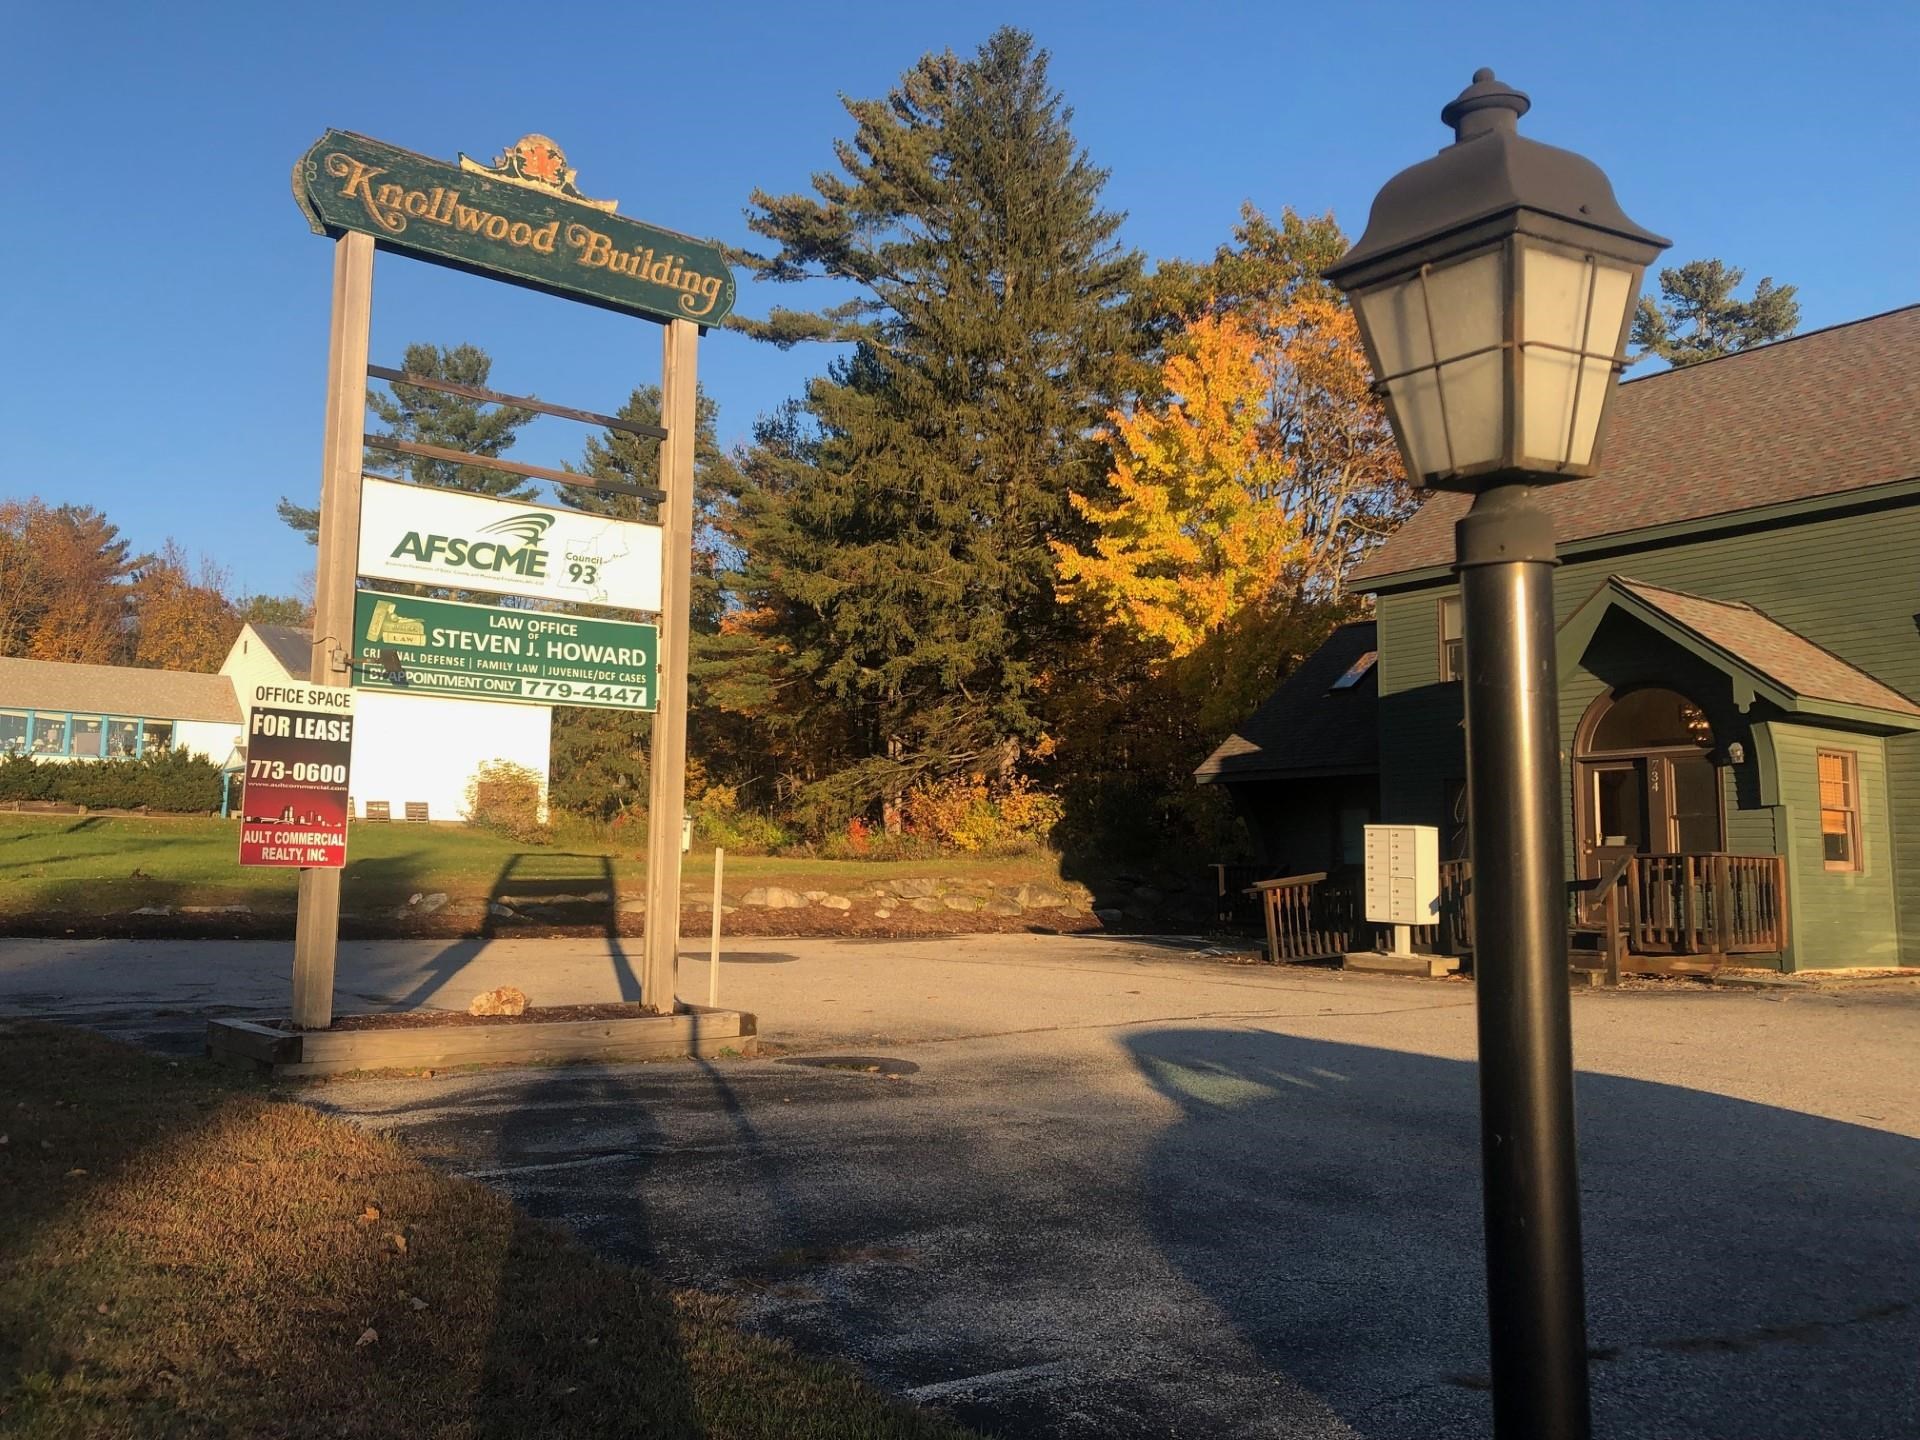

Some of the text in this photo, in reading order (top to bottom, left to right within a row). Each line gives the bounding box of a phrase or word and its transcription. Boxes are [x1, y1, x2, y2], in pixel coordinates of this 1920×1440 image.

[324, 152, 724, 316] Knollwood Building
[390, 531, 549, 578] AFSCME
[565, 551, 603, 565] Council
[568, 563, 597, 585] 93
[489, 615, 578, 637] LAW OFFICE
[527, 632, 540, 641] OF
[431, 628, 647, 668] STEVEN J. HOWARD
[362, 647, 647, 684] CRINAL DEFENSE FAMILY LAW JUVENILE/DCF CASES
[256, 685, 351, 708] OFFICE SPACE
[369, 668, 643, 703] BY APPOINTMENT ONLY 779-4447
[252, 713, 350, 742] FOR LEASE
[250, 760, 346, 784] 773-0600
[1651, 759, 1659, 792] 734
[248, 782, 347, 791] www.aultcommercial.com
[243, 830, 345, 846] AULT COMMERCIAL
[262, 847, 329, 864] REALTY, INC.
